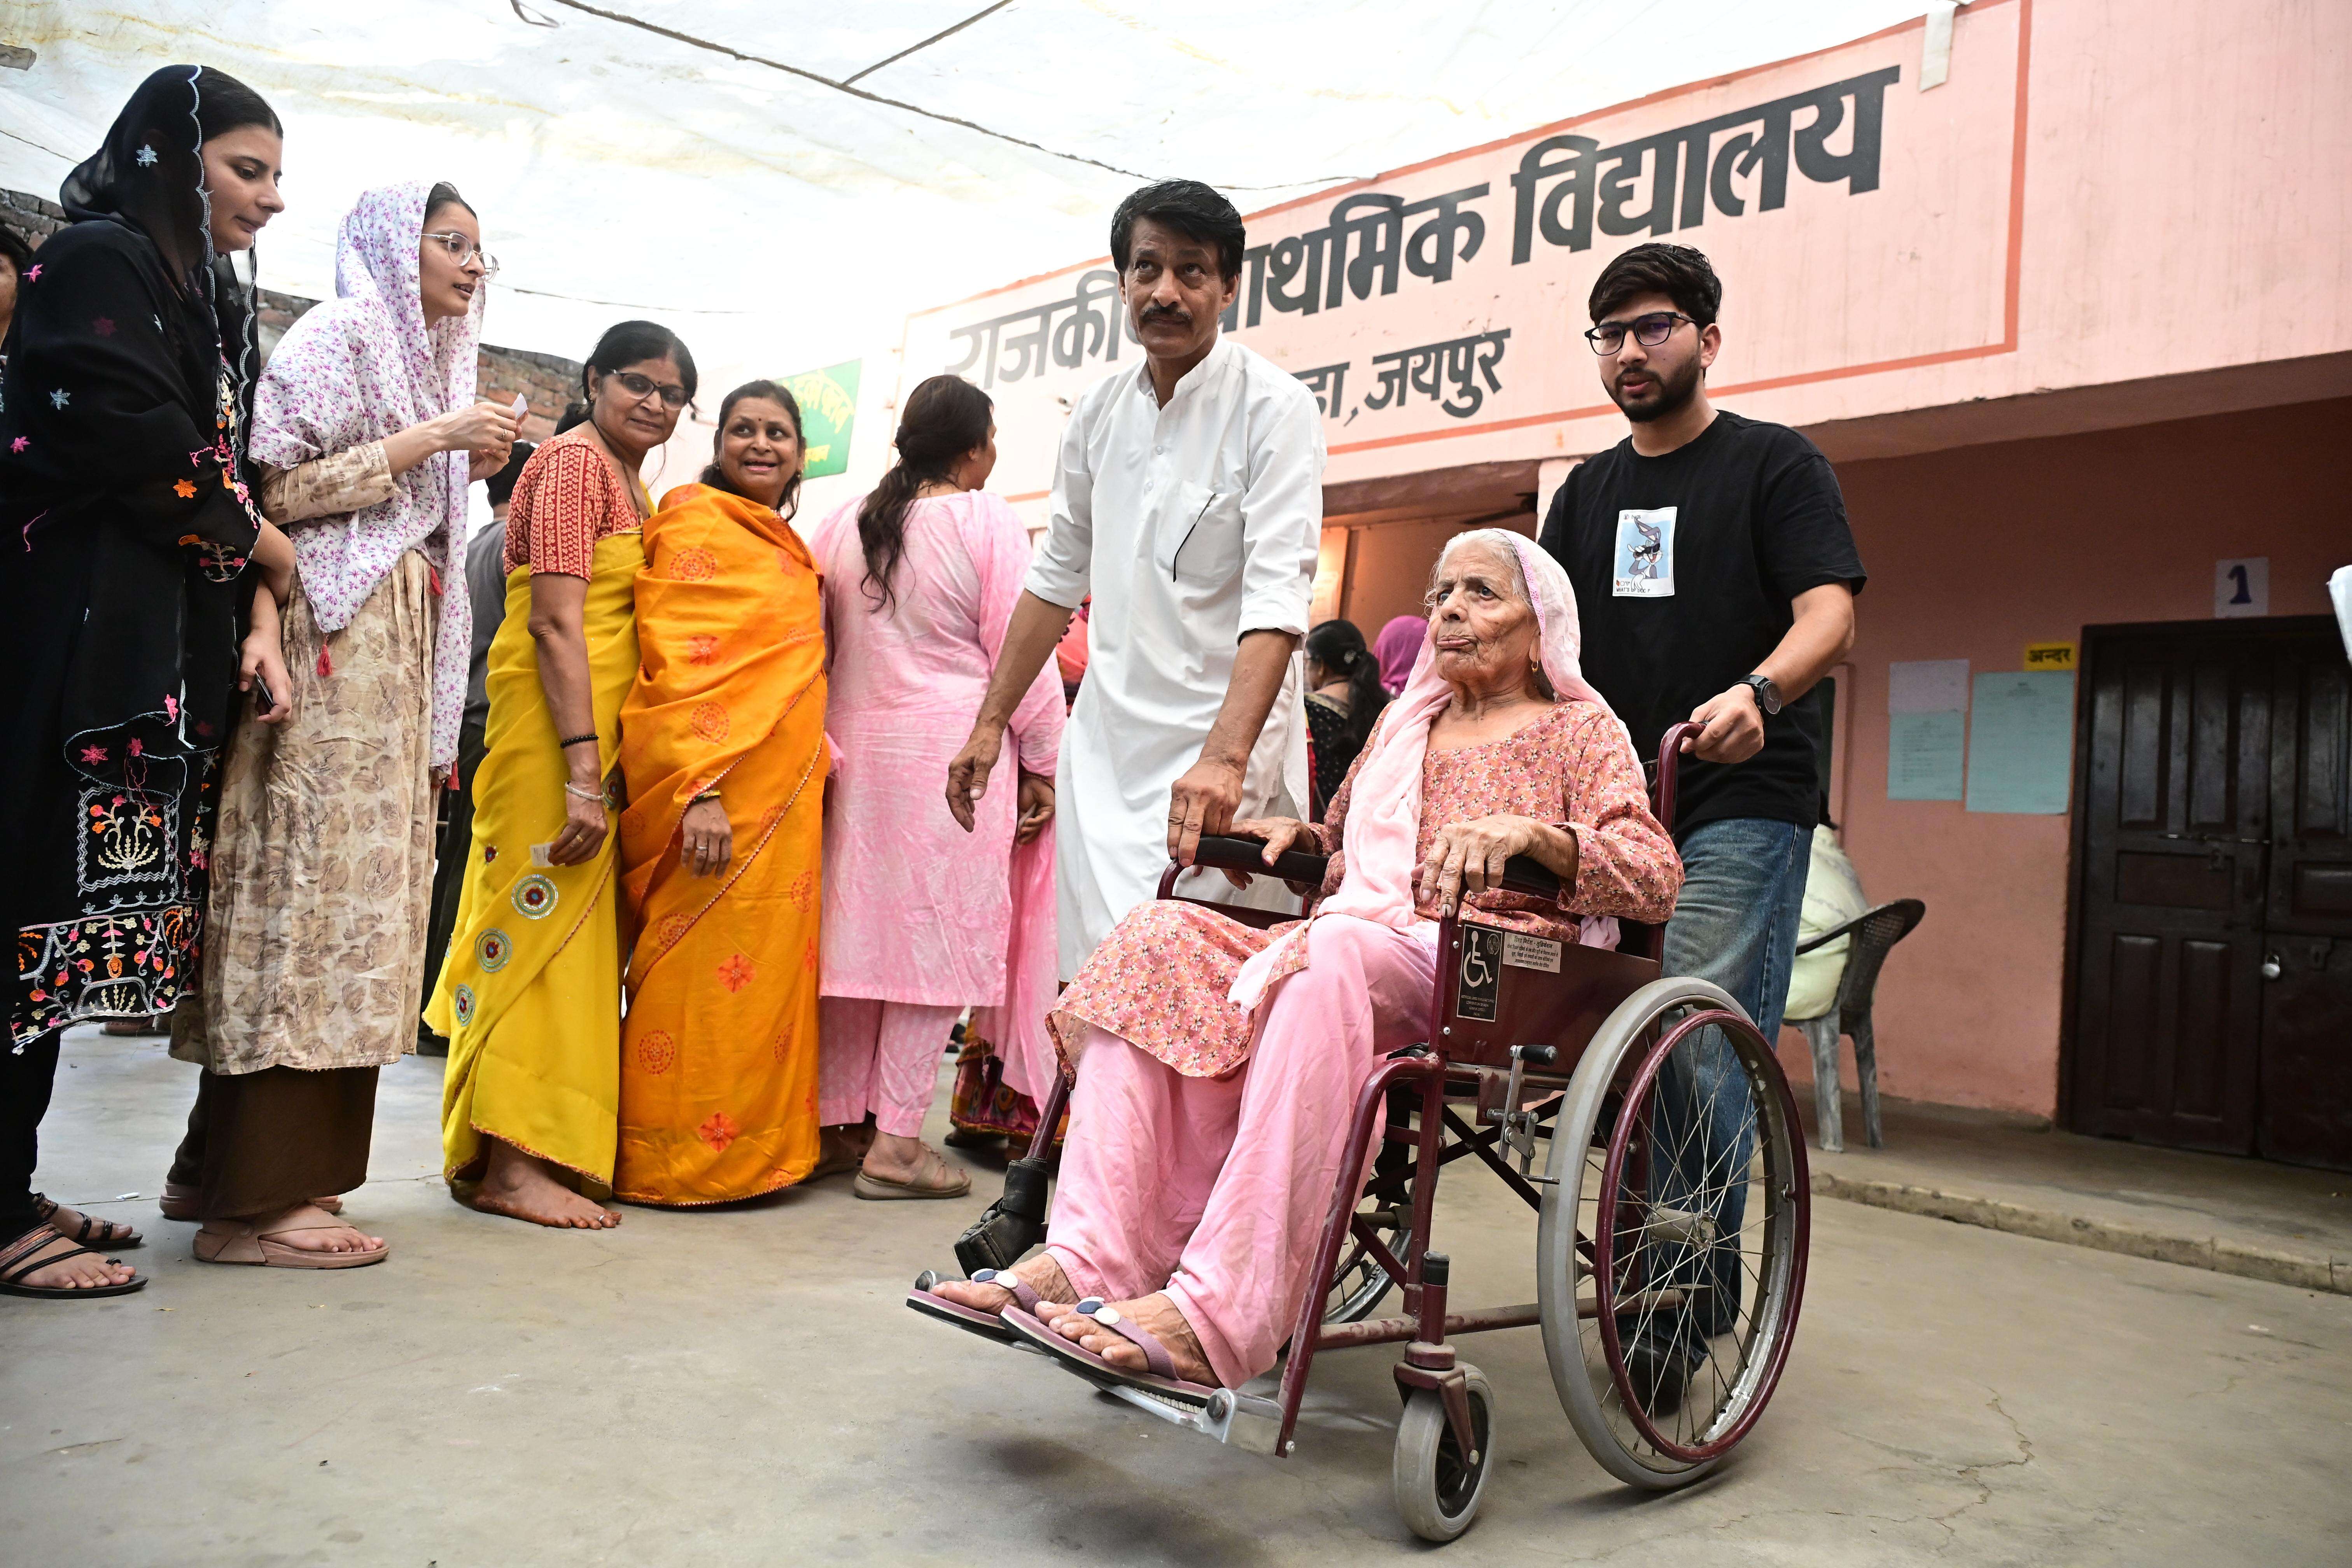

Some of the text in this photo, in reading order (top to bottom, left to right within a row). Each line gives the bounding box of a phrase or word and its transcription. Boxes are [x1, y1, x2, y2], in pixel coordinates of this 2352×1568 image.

[944, 270, 1142, 390] राजकी
[1510, 65, 1900, 265] विद्यालय
[1364, 328, 1511, 418] जयपुर
[2228, 565, 2252, 605] 1
